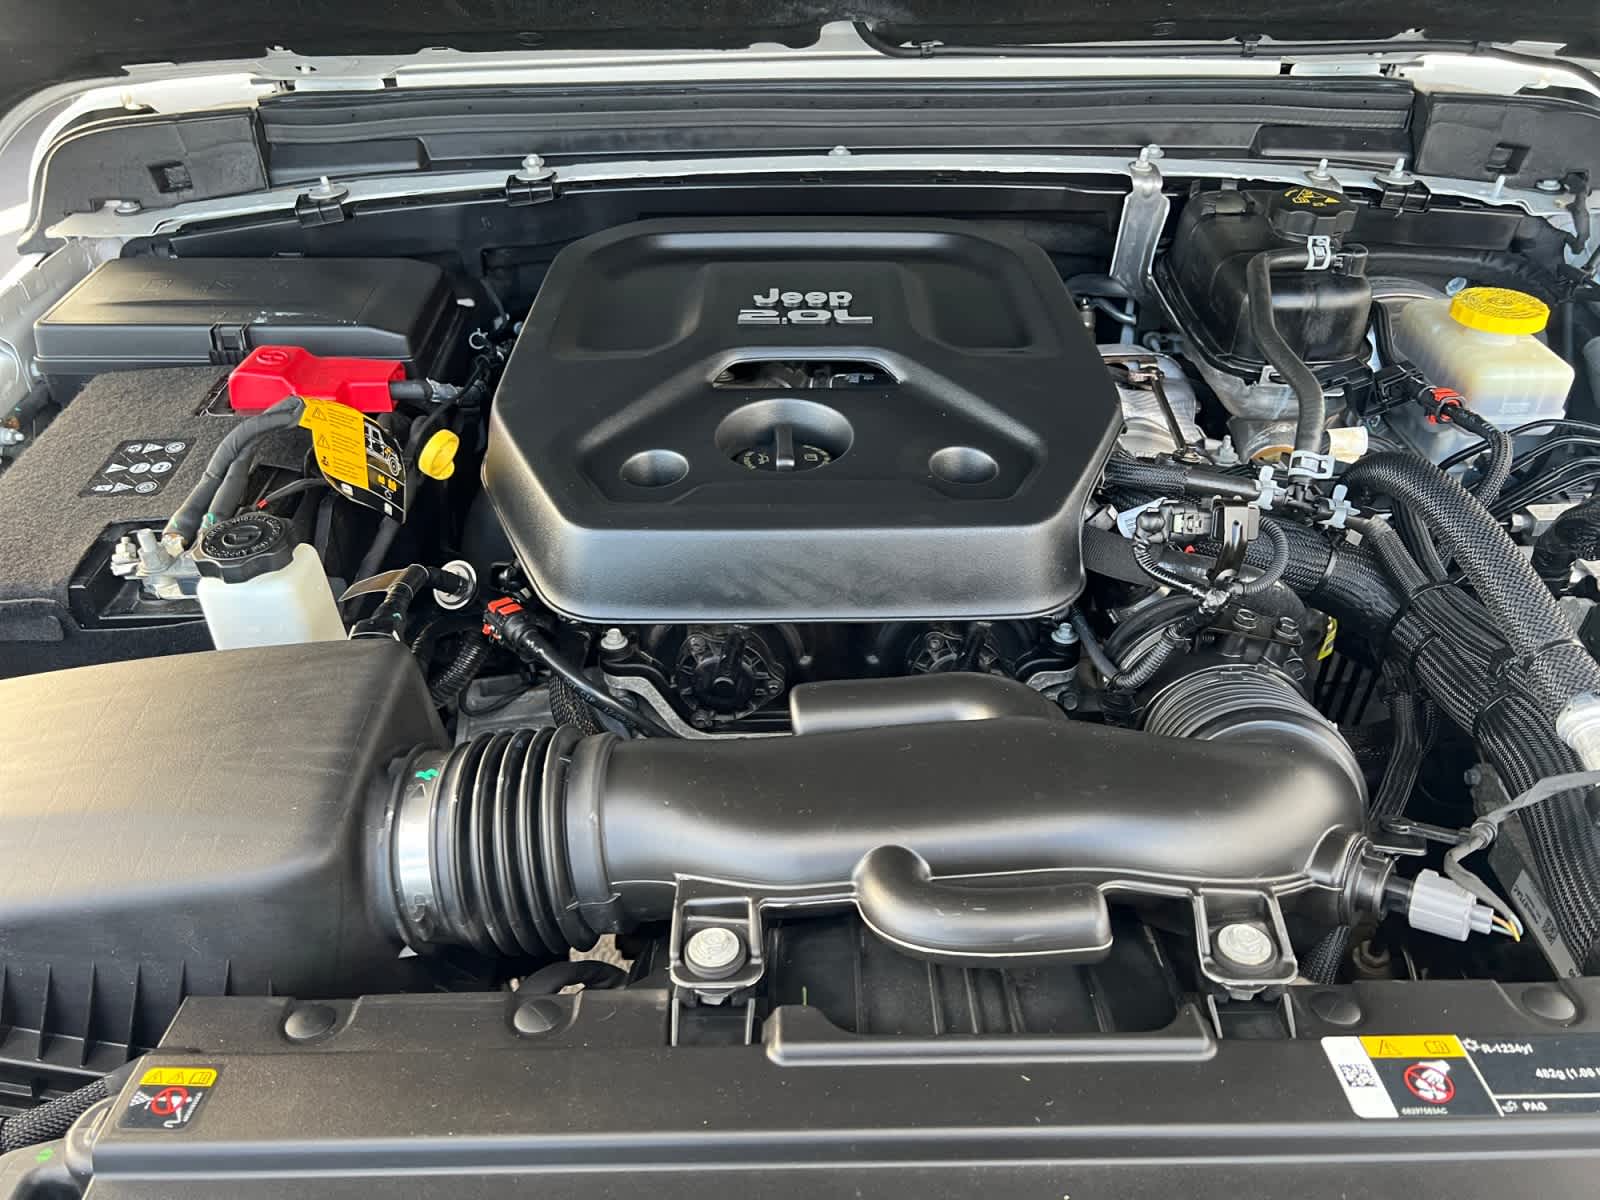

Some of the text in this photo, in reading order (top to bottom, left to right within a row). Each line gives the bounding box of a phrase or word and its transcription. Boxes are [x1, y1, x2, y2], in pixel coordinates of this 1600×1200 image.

[753, 288, 853, 309] Jeep
[737, 309, 873, 325] 2.0L
[1522, 1101, 1548, 1112] PAG
